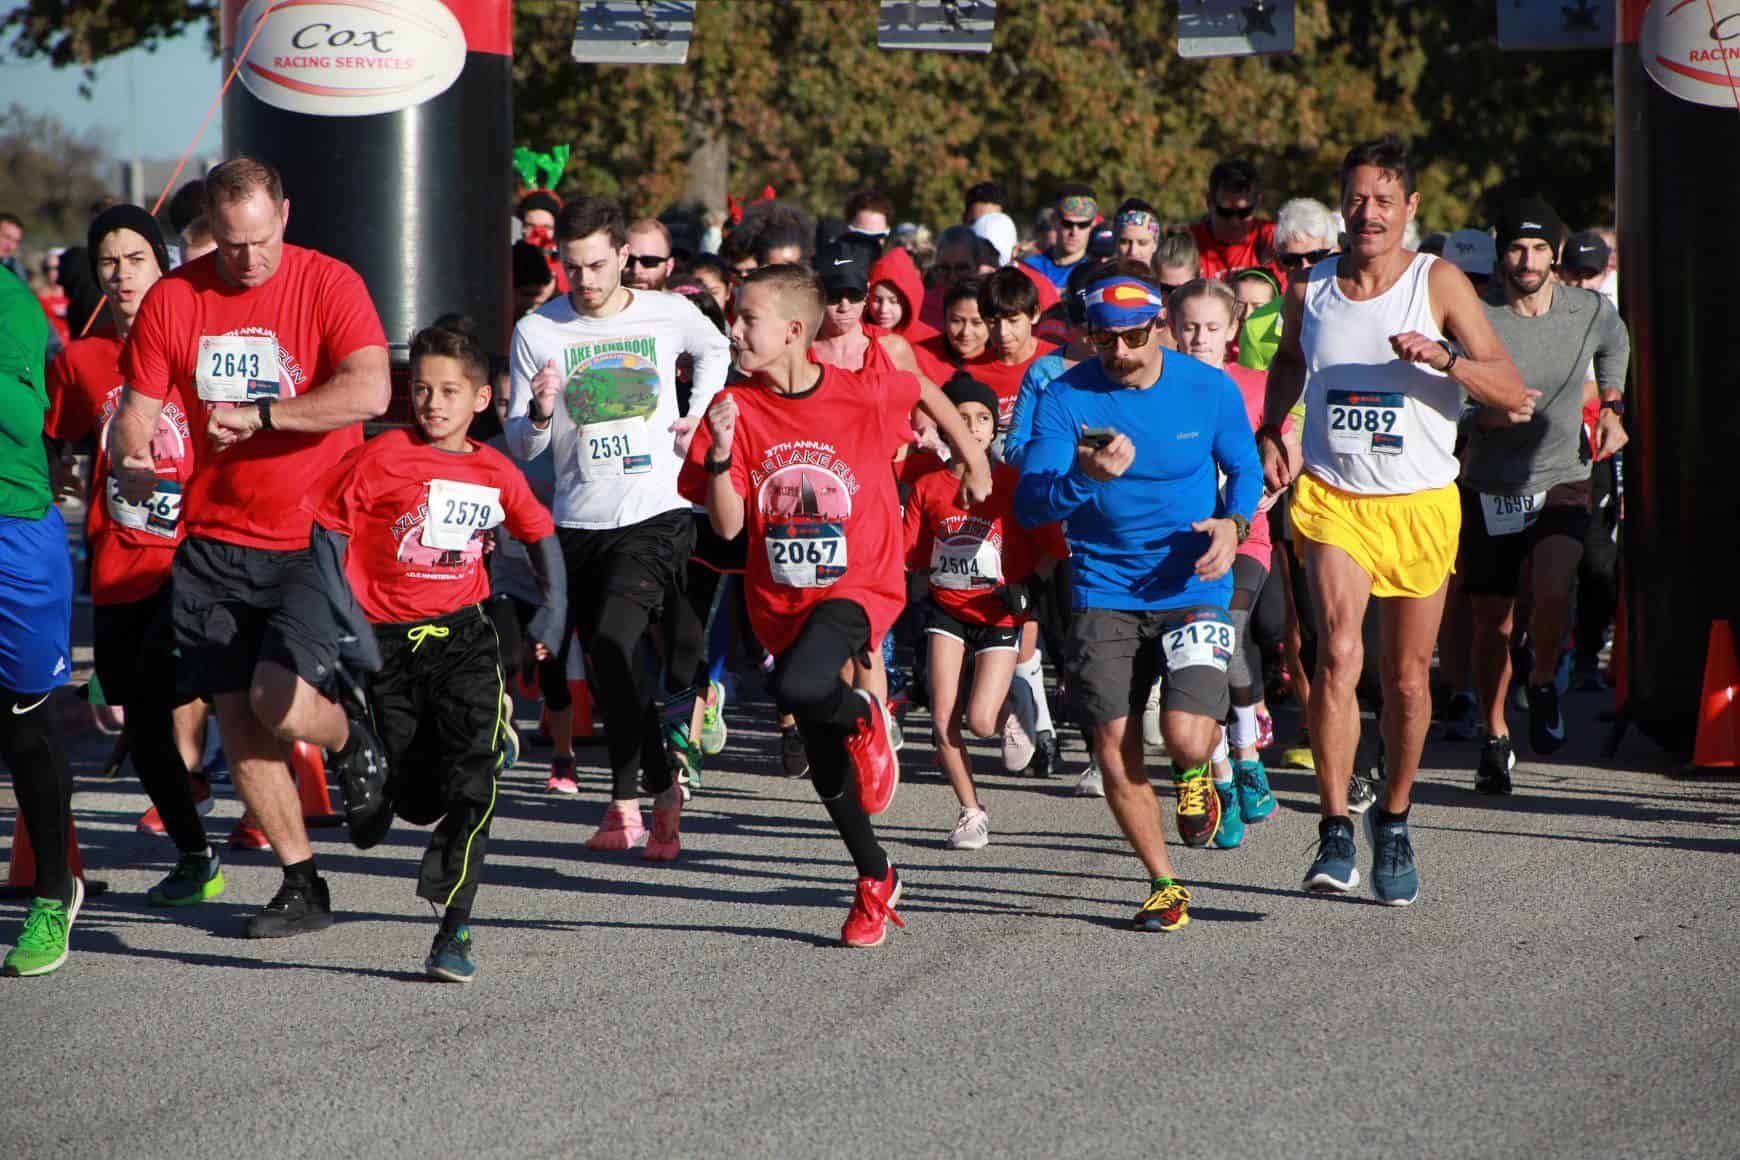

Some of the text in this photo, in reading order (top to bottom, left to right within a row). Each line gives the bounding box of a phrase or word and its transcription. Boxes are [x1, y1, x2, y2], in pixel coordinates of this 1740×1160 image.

[291, 23, 393, 53] Cox
[273, 56, 415, 71] RACING SERVICES
[1689, 48, 1740, 62] RACIN
[212, 353, 259, 378] 2643
[563, 345, 592, 376] LAKE
[1332, 407, 1397, 432] 2089
[590, 434, 631, 459] 2531
[775, 449, 833, 467] LAKE
[793, 440, 836, 454] ANNUAL
[443, 499, 491, 527] 2579
[772, 540, 838, 564] 2067
[940, 555, 979, 576] 2504
[1169, 624, 1230, 650] 2128
